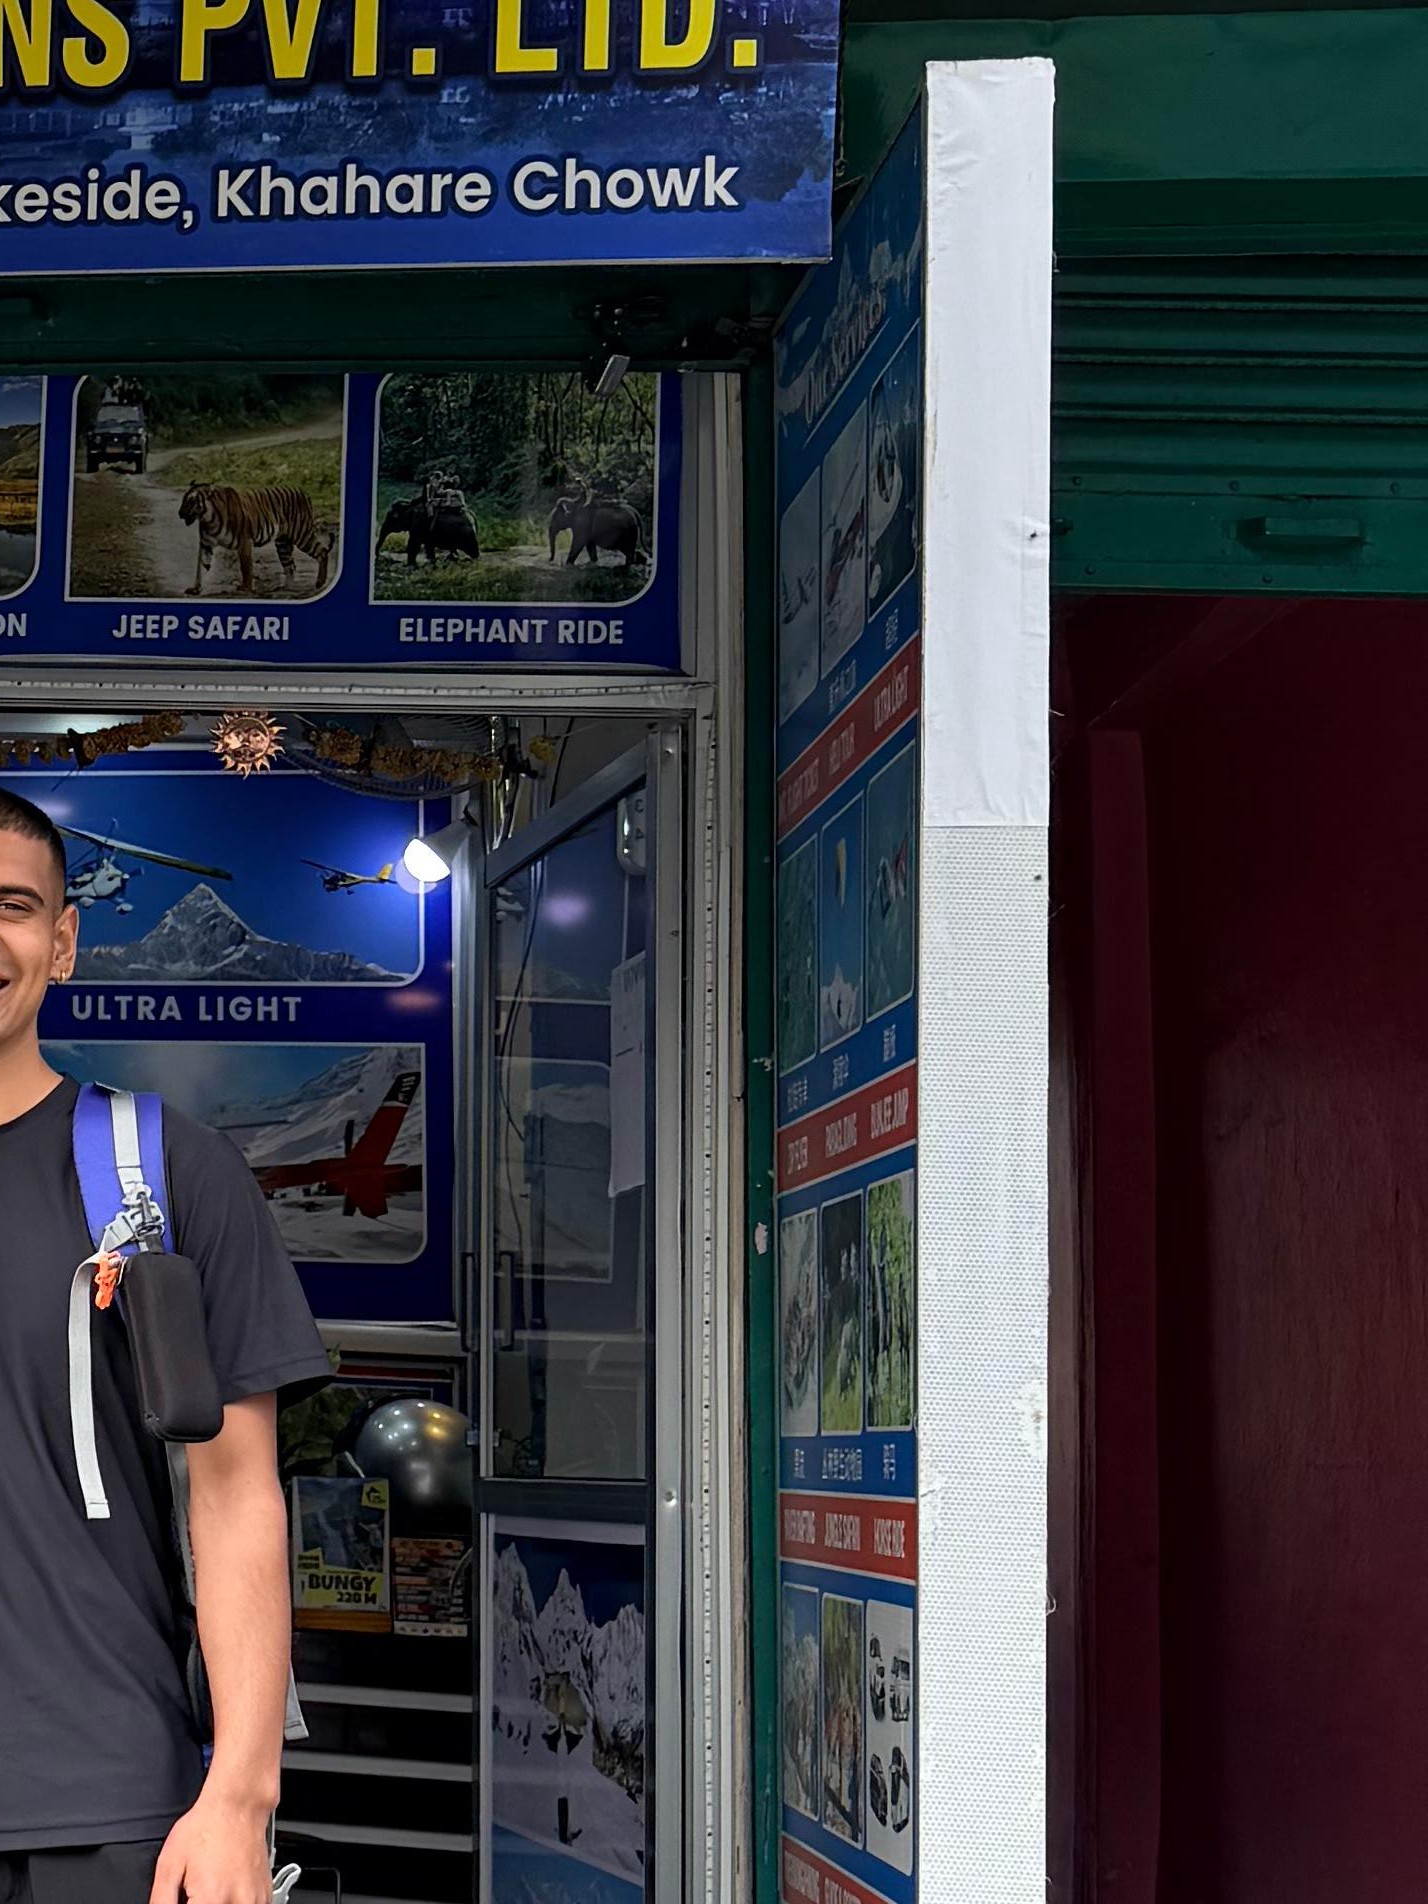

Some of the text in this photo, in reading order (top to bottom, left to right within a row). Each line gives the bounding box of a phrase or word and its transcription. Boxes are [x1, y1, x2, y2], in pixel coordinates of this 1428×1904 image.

[216, 158, 491, 222] Khahare
[510, 152, 741, 213] Chowk
[112, 613, 291, 643] JEEP SAFARI
[398, 616, 625, 646] ELEPHANT RIDE
[71, 995, 302, 1024] ULTRA LIGHT
[308, 1573, 376, 1591] BUNGY
